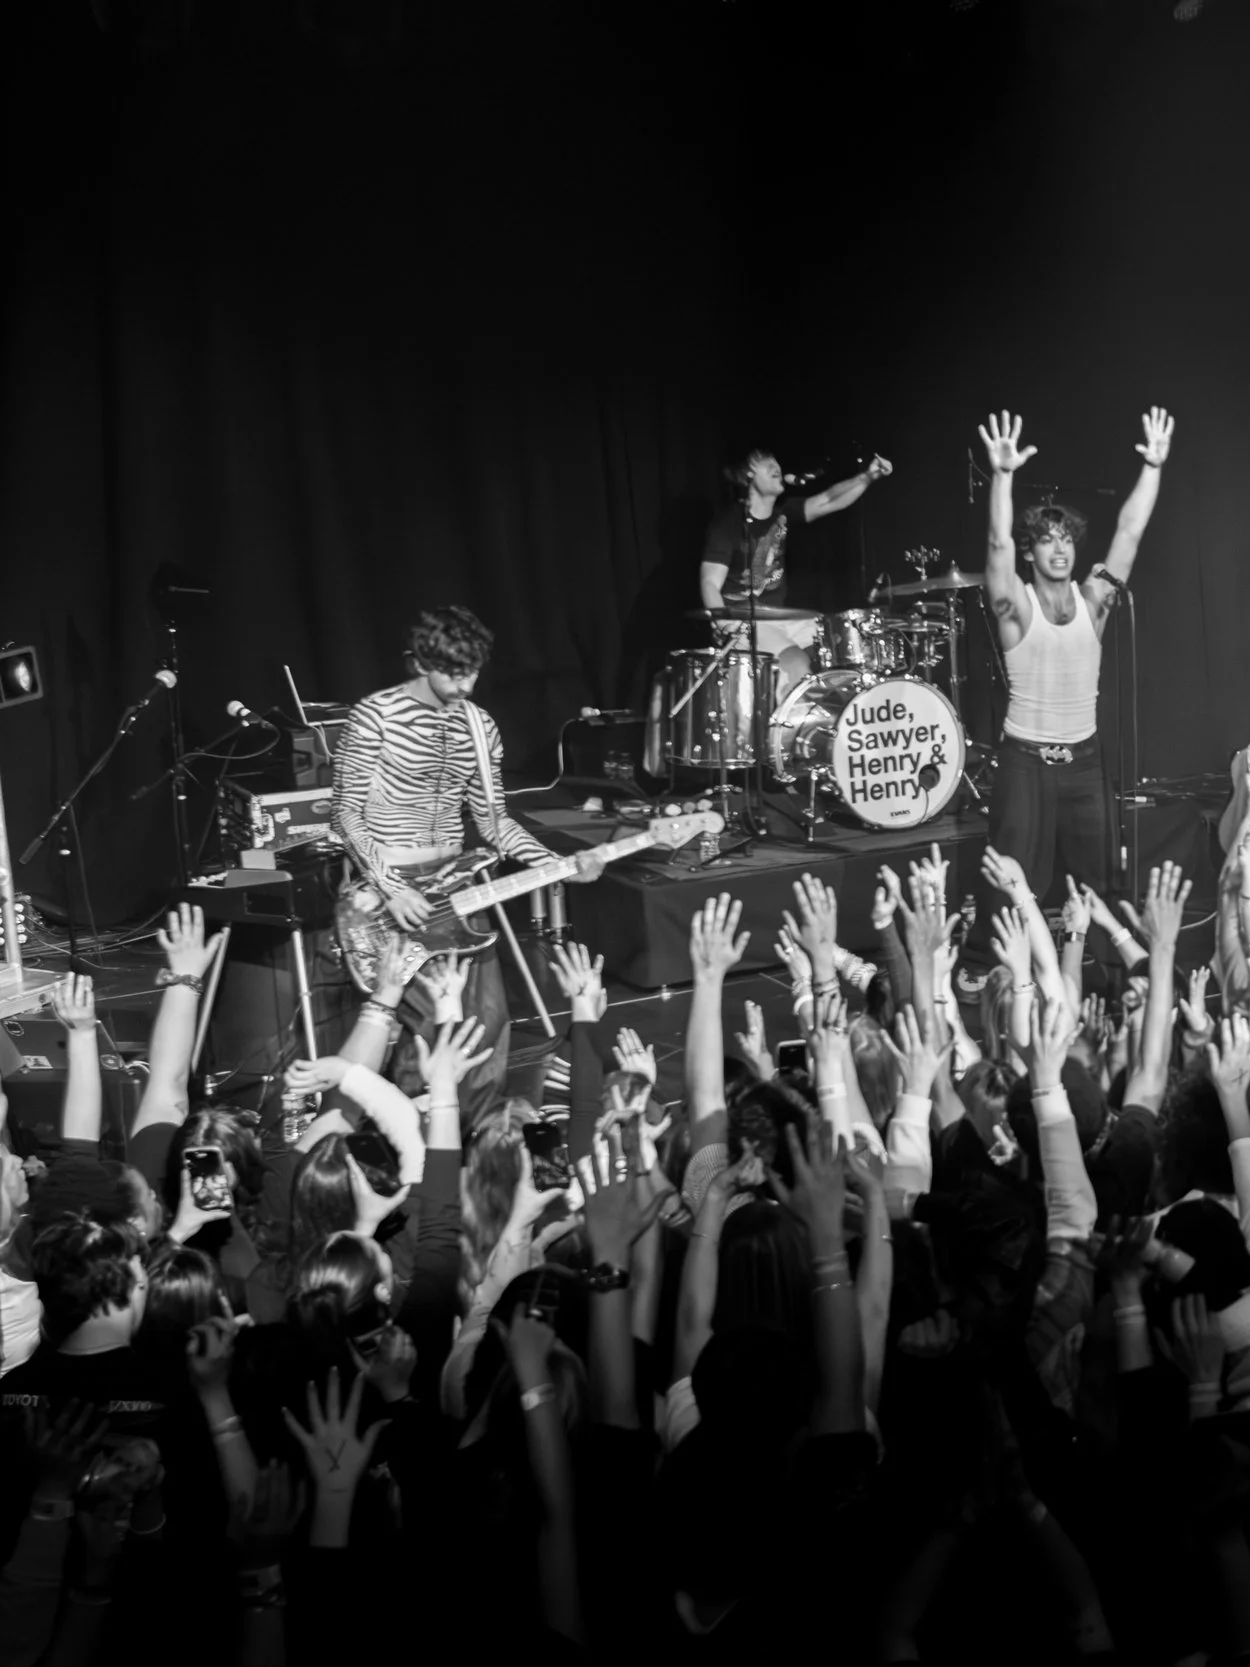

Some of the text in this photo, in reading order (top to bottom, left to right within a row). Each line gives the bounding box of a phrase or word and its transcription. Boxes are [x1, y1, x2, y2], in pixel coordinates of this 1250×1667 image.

[845, 699, 914, 727] Jude,
[847, 724, 946, 752] Sawyer,
[848, 744, 948, 778] Henry &
[850, 777, 921, 804] Henry
